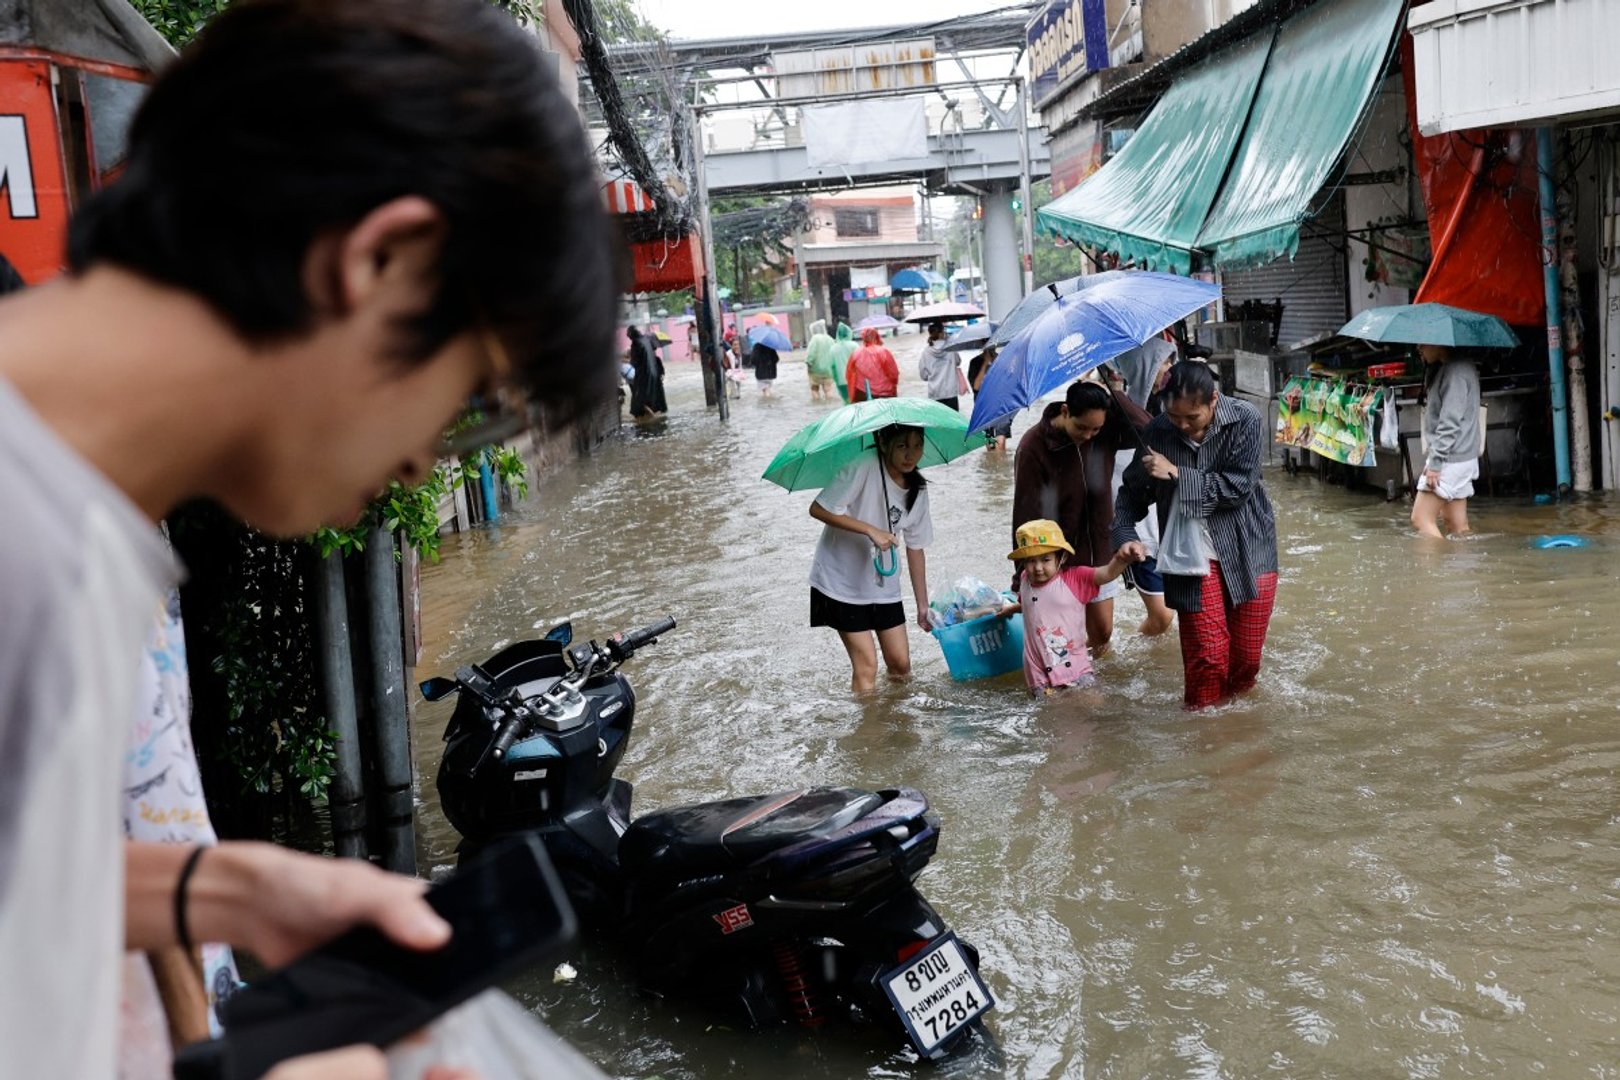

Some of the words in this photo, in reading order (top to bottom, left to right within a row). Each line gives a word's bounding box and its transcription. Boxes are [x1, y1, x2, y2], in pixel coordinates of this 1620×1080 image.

[906, 969, 972, 1021] กรุงเทพมหานคร
[924, 990, 979, 1041] 7284
